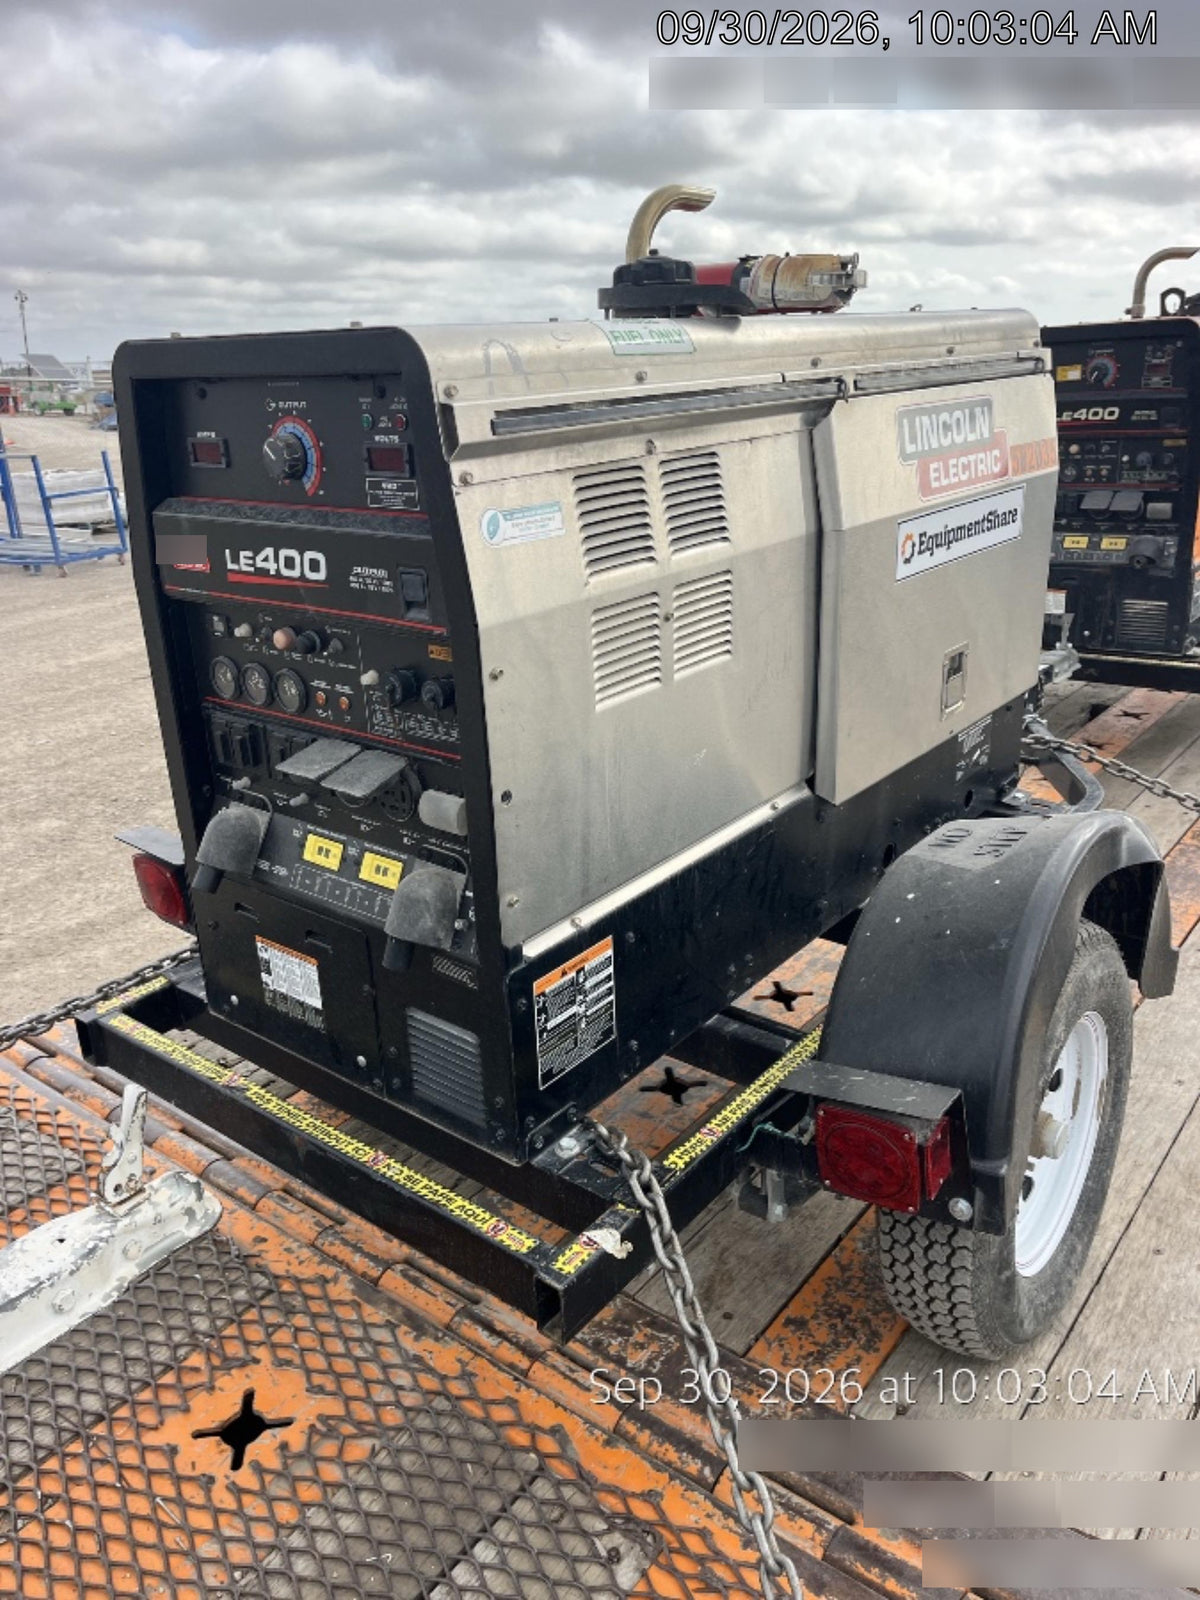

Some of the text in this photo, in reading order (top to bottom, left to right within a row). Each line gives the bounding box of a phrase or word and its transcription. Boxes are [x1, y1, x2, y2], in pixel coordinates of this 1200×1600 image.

[903, 405, 990, 454] LINCOLN
[929, 448, 1002, 489] ELECTRIC
[917, 505, 1018, 558] EquipmentShare
[224, 546, 327, 581] LE400
[420, 1182, 459, 1206] PARE
